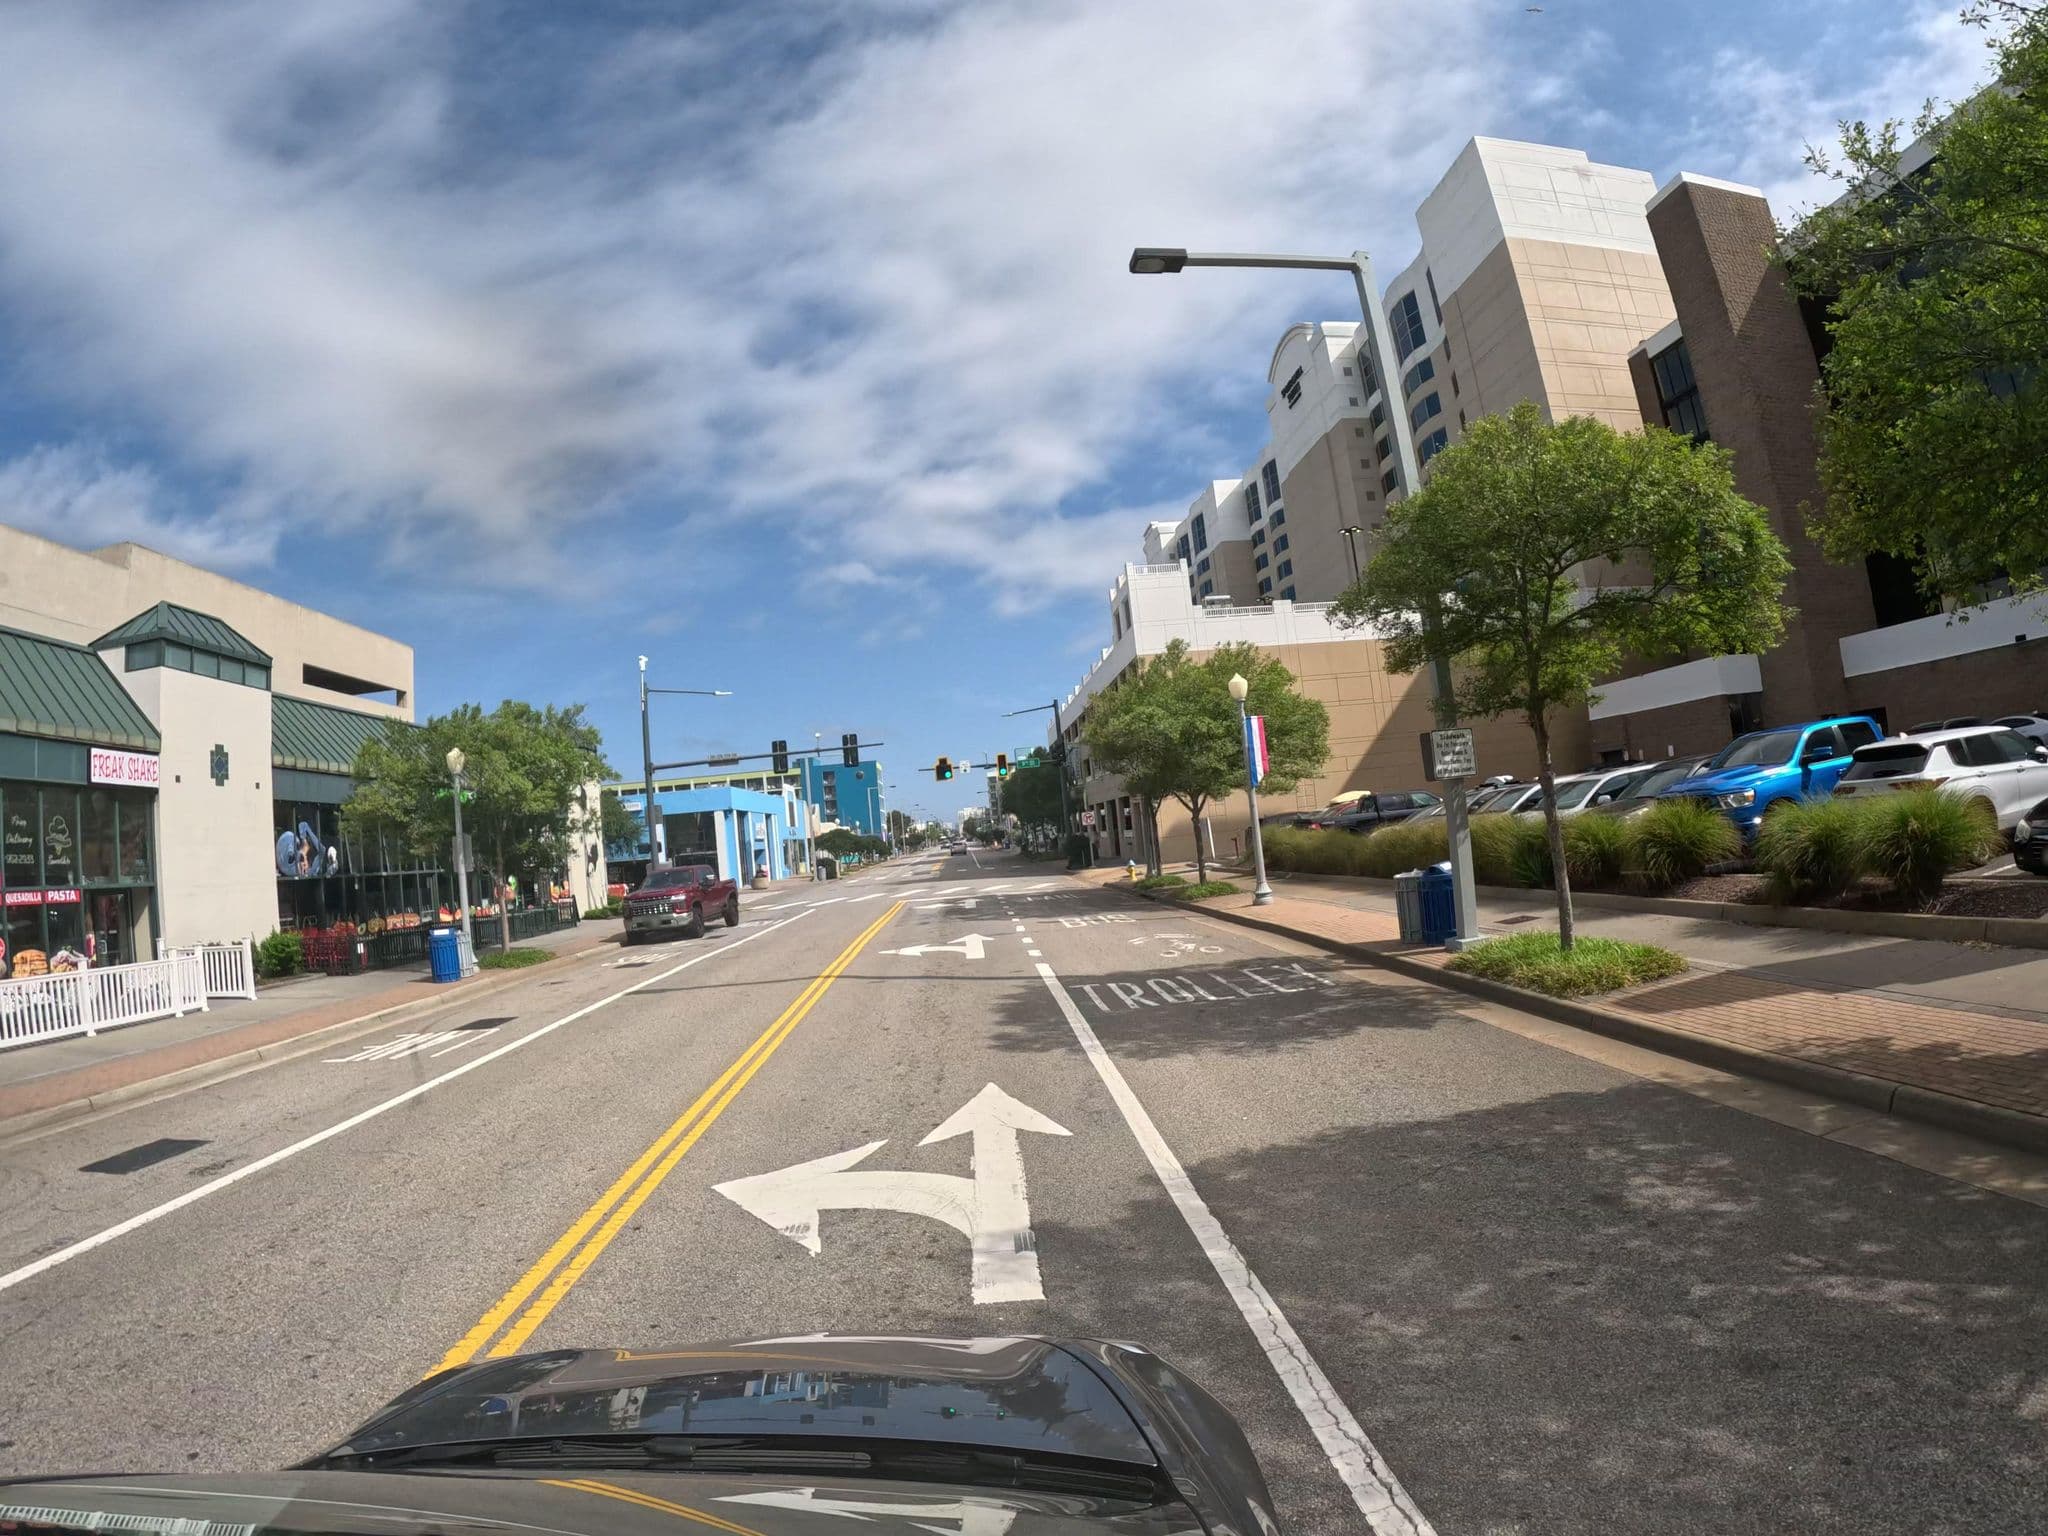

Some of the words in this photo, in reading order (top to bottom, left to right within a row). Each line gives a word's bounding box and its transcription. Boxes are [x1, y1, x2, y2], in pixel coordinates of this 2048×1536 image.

[92, 754, 125, 779] FREAK
[127, 757, 158, 782] SHAKE
[5, 891, 42, 904] QUESADILLA
[48, 890, 76, 901] PASTA
[1069, 963, 1336, 1013] TROLLEY
